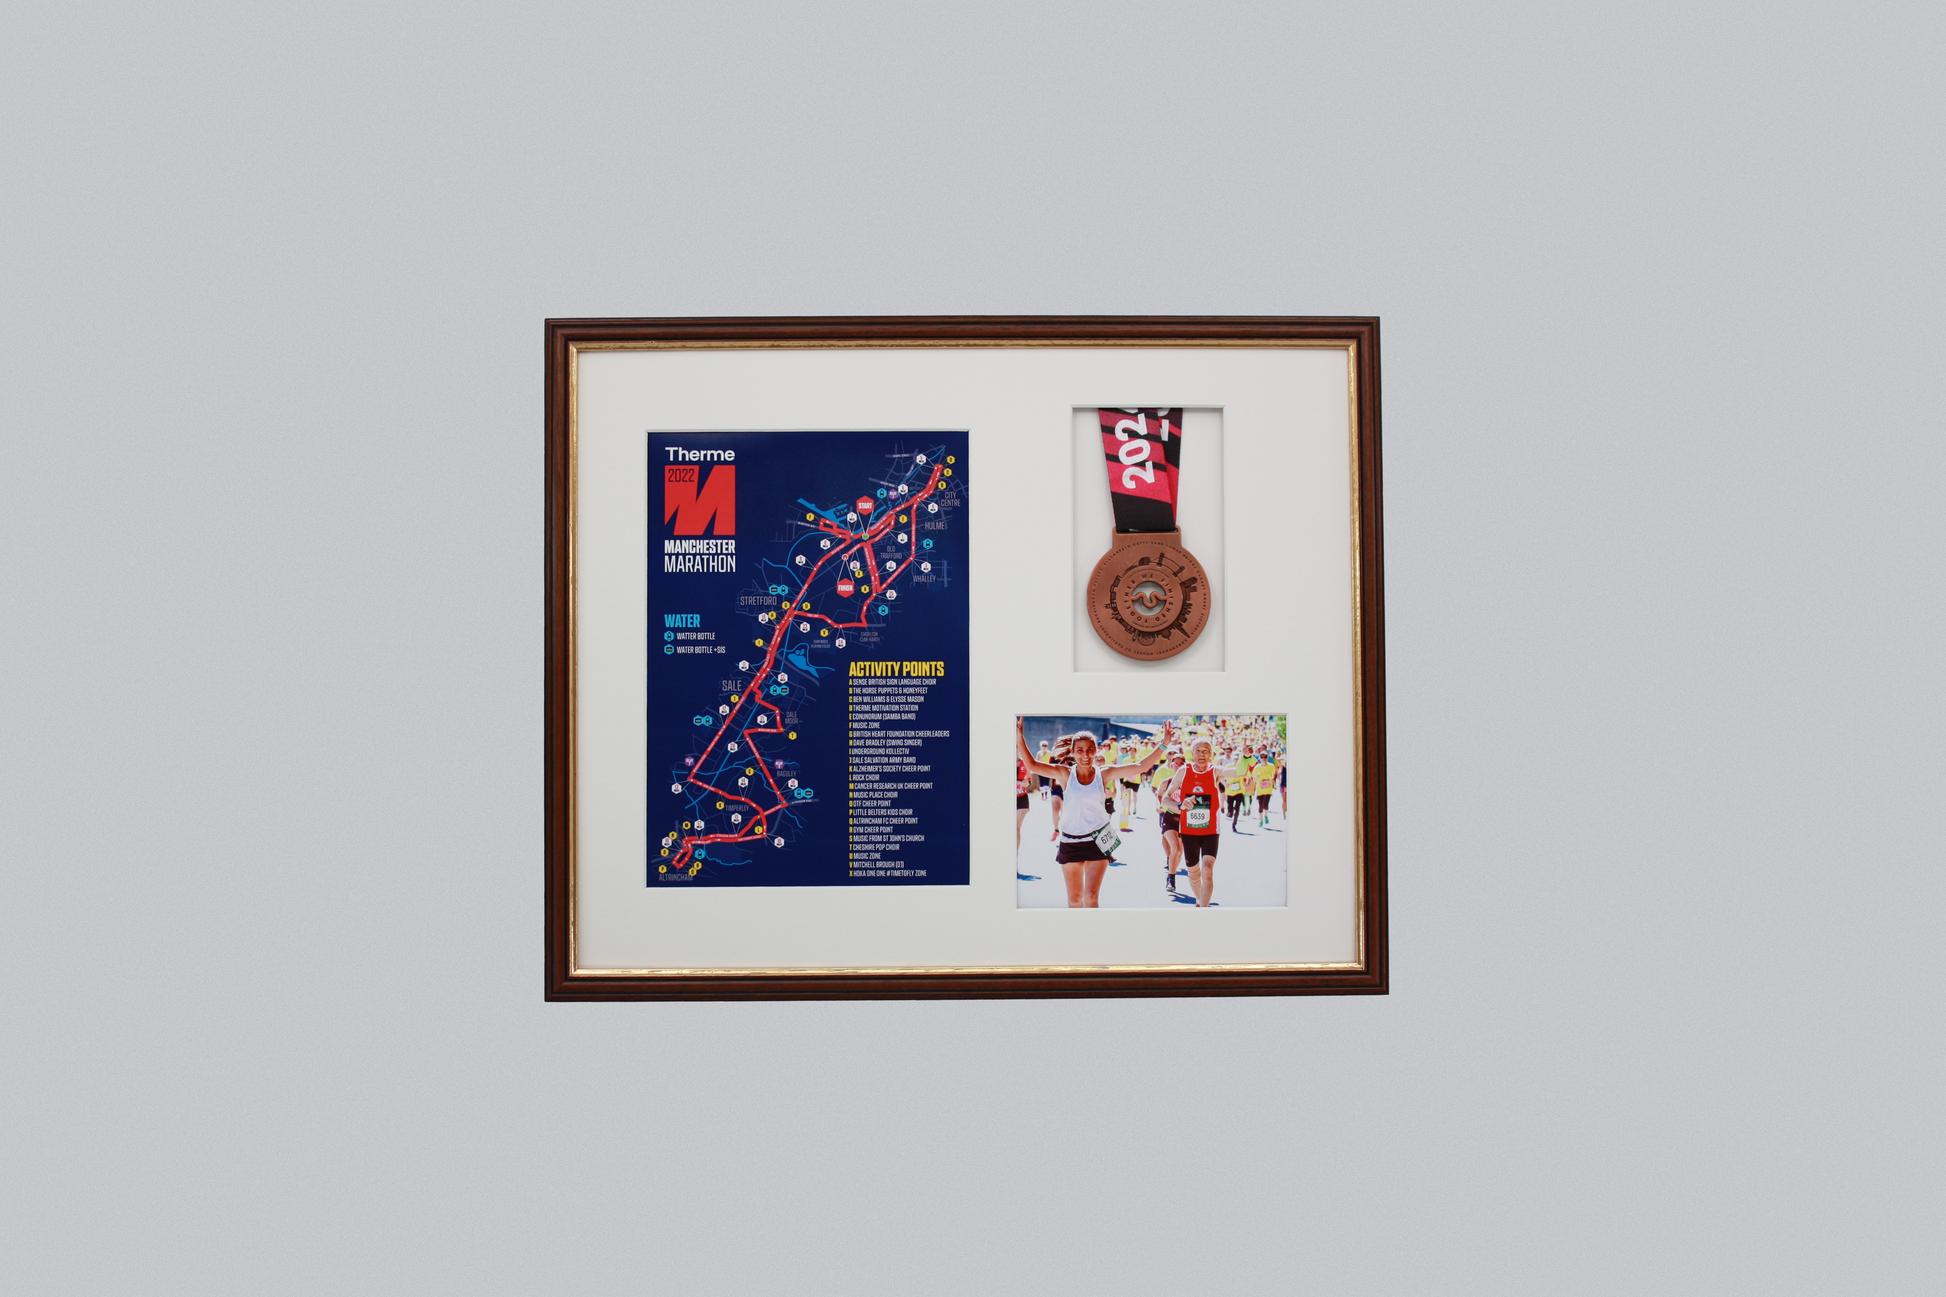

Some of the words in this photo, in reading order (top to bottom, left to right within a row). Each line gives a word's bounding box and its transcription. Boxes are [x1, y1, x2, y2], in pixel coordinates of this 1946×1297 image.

[665, 447, 735, 461] Therme
[1115, 408, 1155, 489] 202
[668, 468, 694, 482] 2022
[664, 540, 735, 553] MANCHESTER
[664, 555, 736, 572] MARATHON
[740, 596, 777, 605] STRETFORD
[1124, 580, 1148, 623] TOGETHER
[1155, 579, 1174, 621] FINISHED
[664, 614, 700, 628] WATER
[849, 661, 900, 676] ACTIVITY
[903, 661, 944, 676] POINTS
[722, 680, 741, 691] SALE
[1101, 831, 1114, 844] 6712
